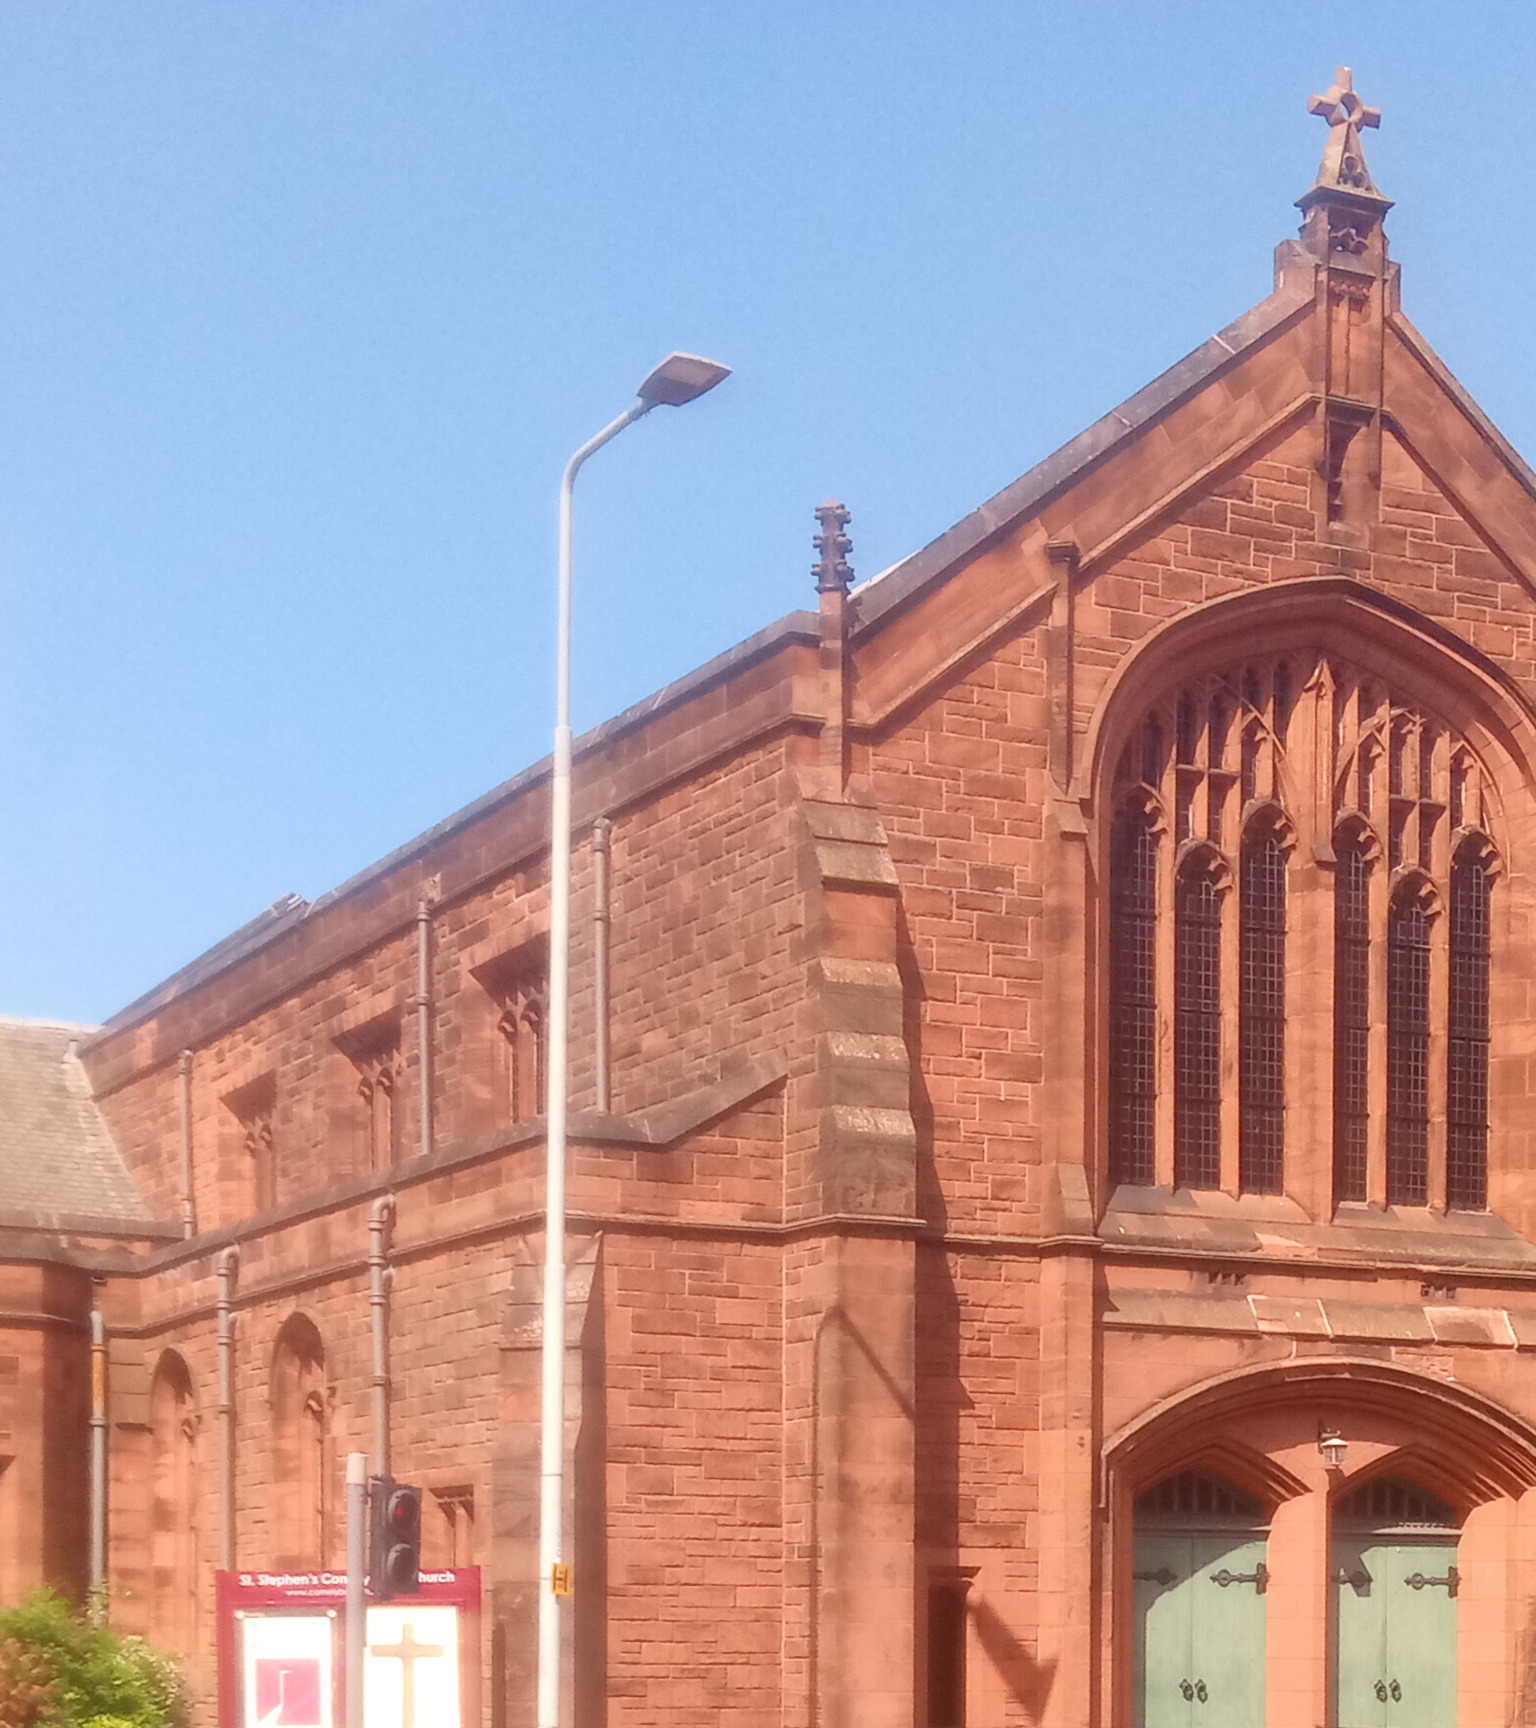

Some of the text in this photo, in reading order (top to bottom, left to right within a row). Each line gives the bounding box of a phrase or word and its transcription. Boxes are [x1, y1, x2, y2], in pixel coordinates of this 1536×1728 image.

[239, 1574, 255, 1586] St.
[257, 1573, 319, 1588] Stephen's
[417, 1571, 456, 1584] hurch
[553, 1565, 568, 1592] H
